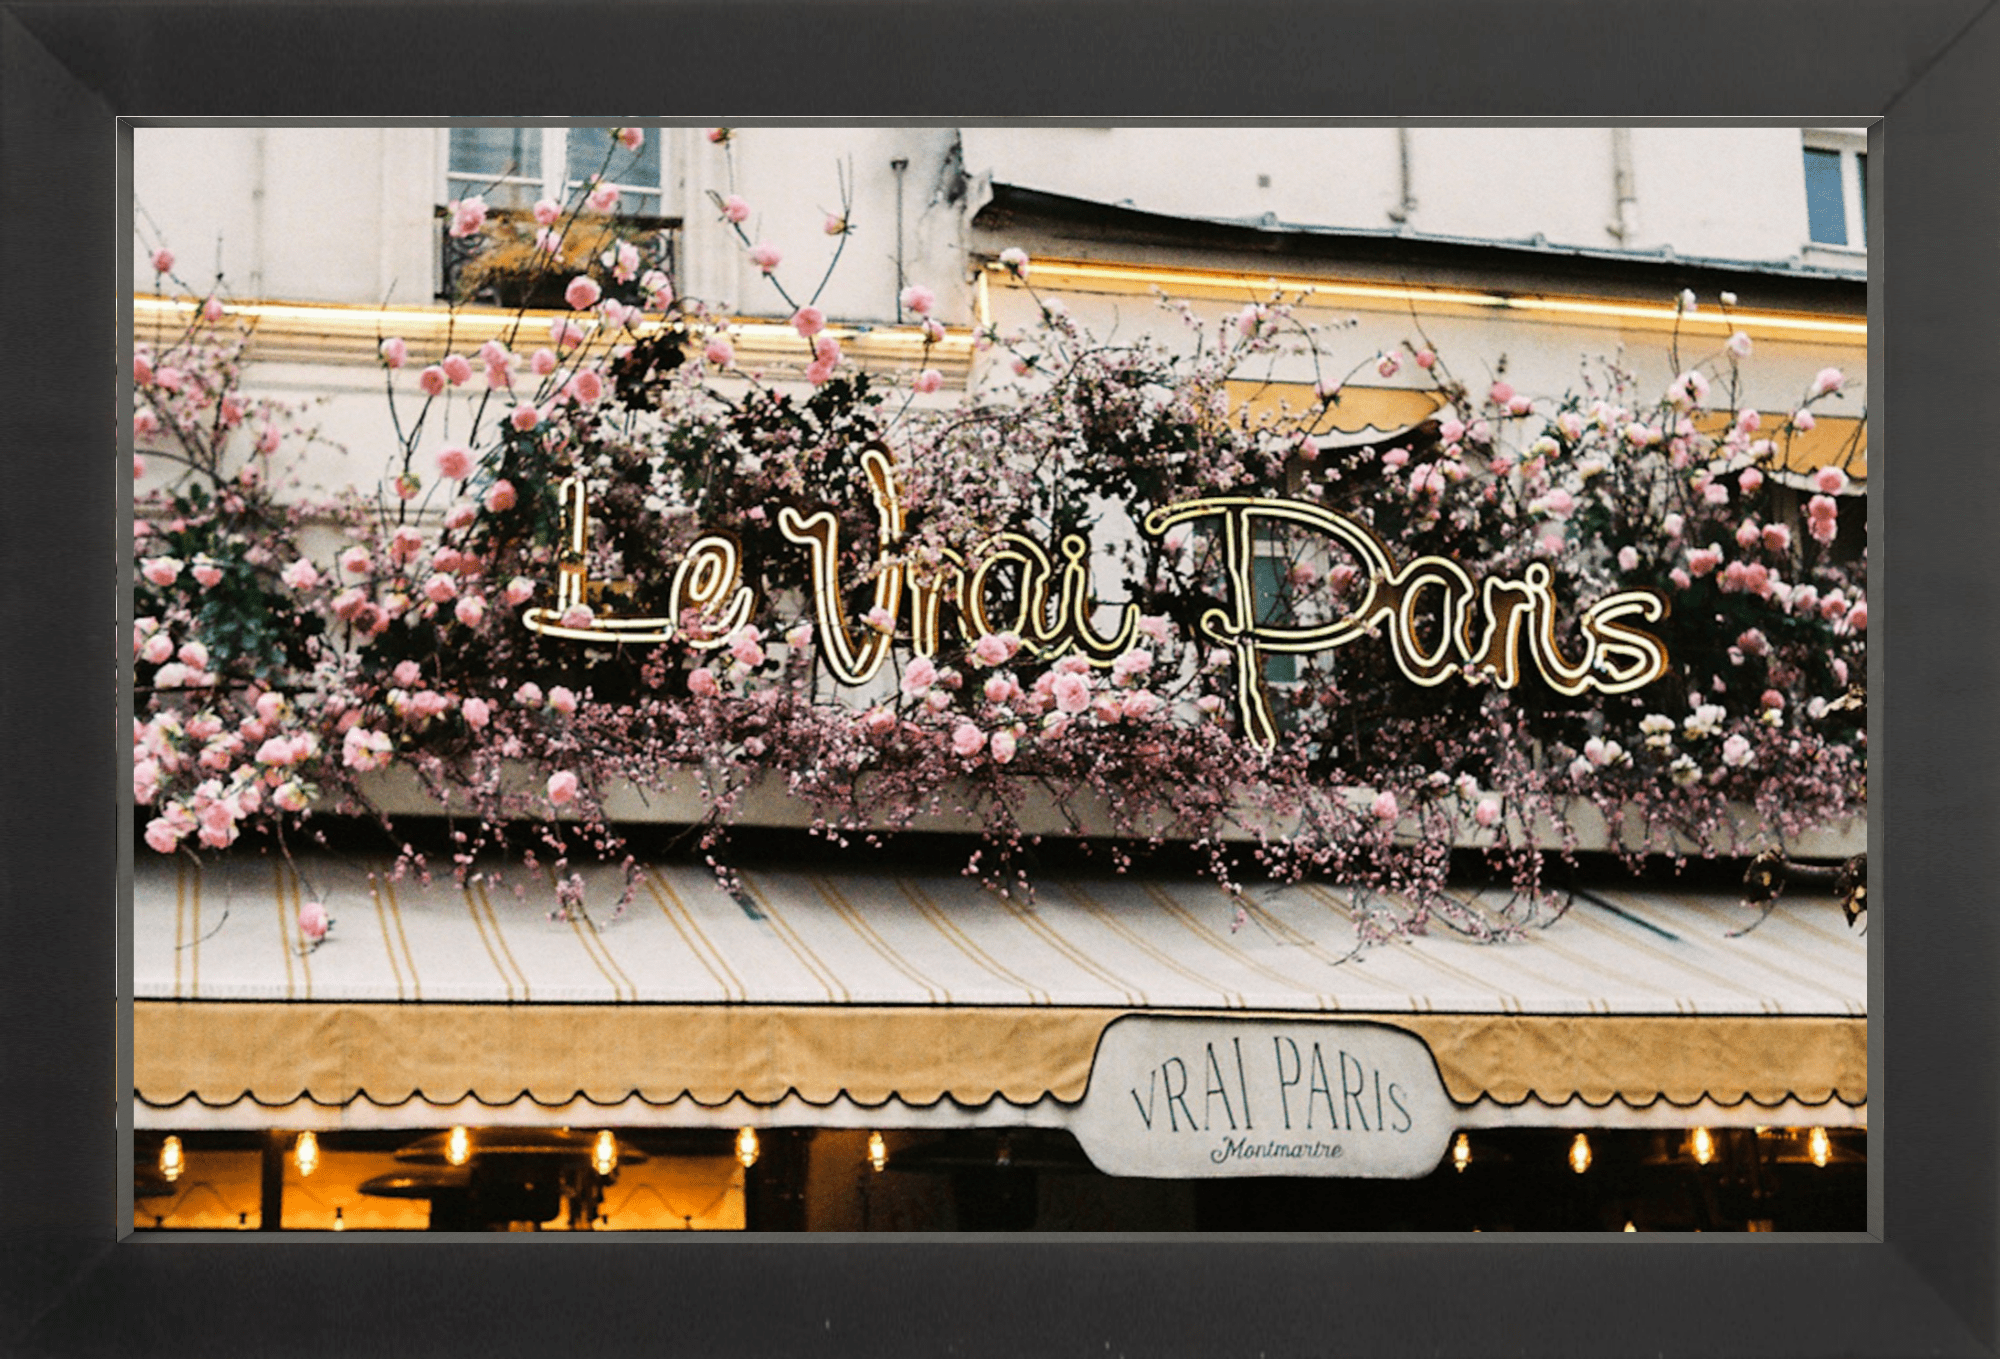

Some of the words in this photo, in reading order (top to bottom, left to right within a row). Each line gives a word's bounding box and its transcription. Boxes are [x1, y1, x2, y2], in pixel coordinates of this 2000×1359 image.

[522, 476, 754, 649] Le
[777, 446, 1141, 686] Vrai
[1144, 496, 1665, 752] Paris
[1130, 1036, 1254, 1133] VRAI
[1273, 1036, 1413, 1133] PARIS
[1210, 1136, 1344, 1164] Montmartre
